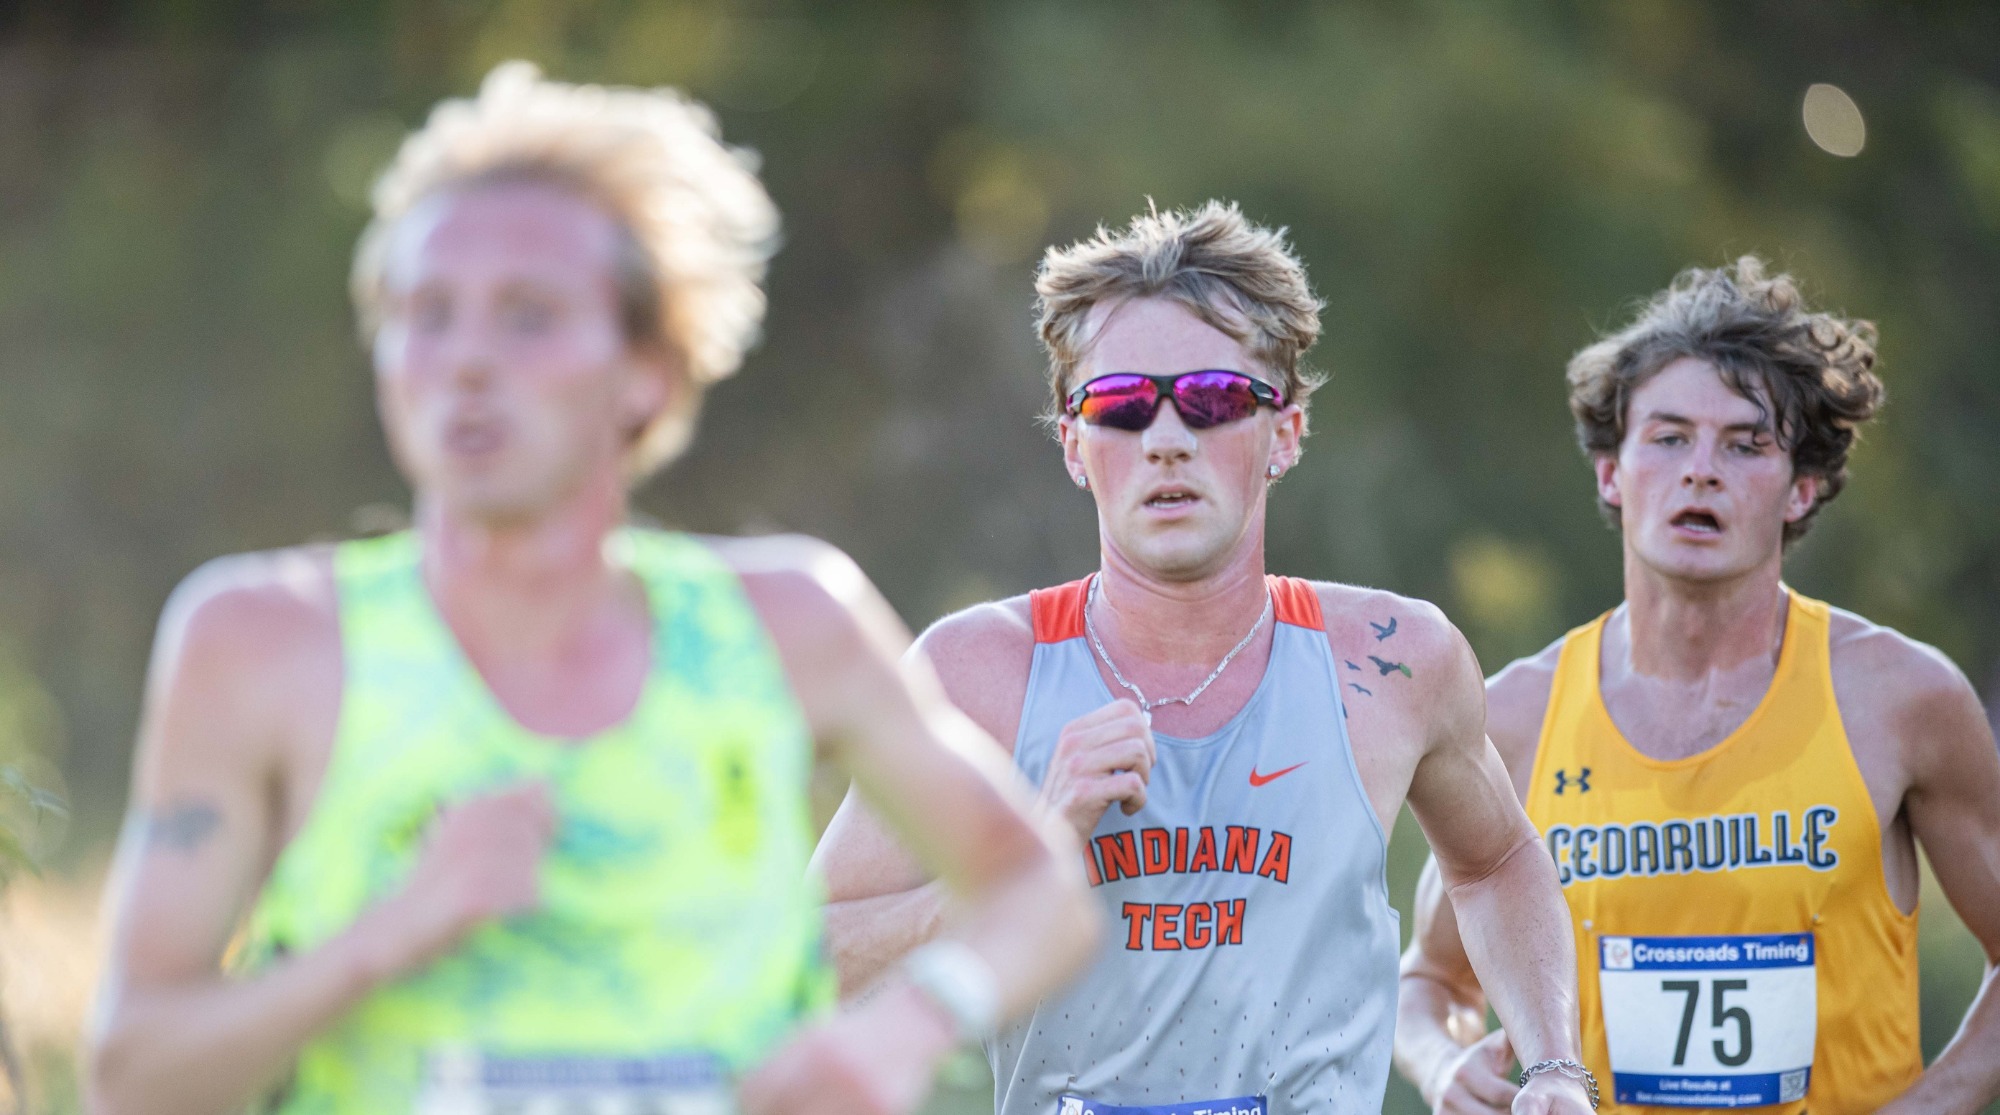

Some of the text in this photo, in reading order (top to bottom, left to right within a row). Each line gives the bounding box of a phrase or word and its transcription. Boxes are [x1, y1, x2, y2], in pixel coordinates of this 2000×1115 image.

[1082, 825, 1292, 888] INDIANA
[1547, 805, 1839, 887] CEDARVILLE
[1122, 898, 1247, 951] TECH
[1633, 941, 1809, 963] Crossroads Timing
[1661, 979, 1753, 1067] 75
